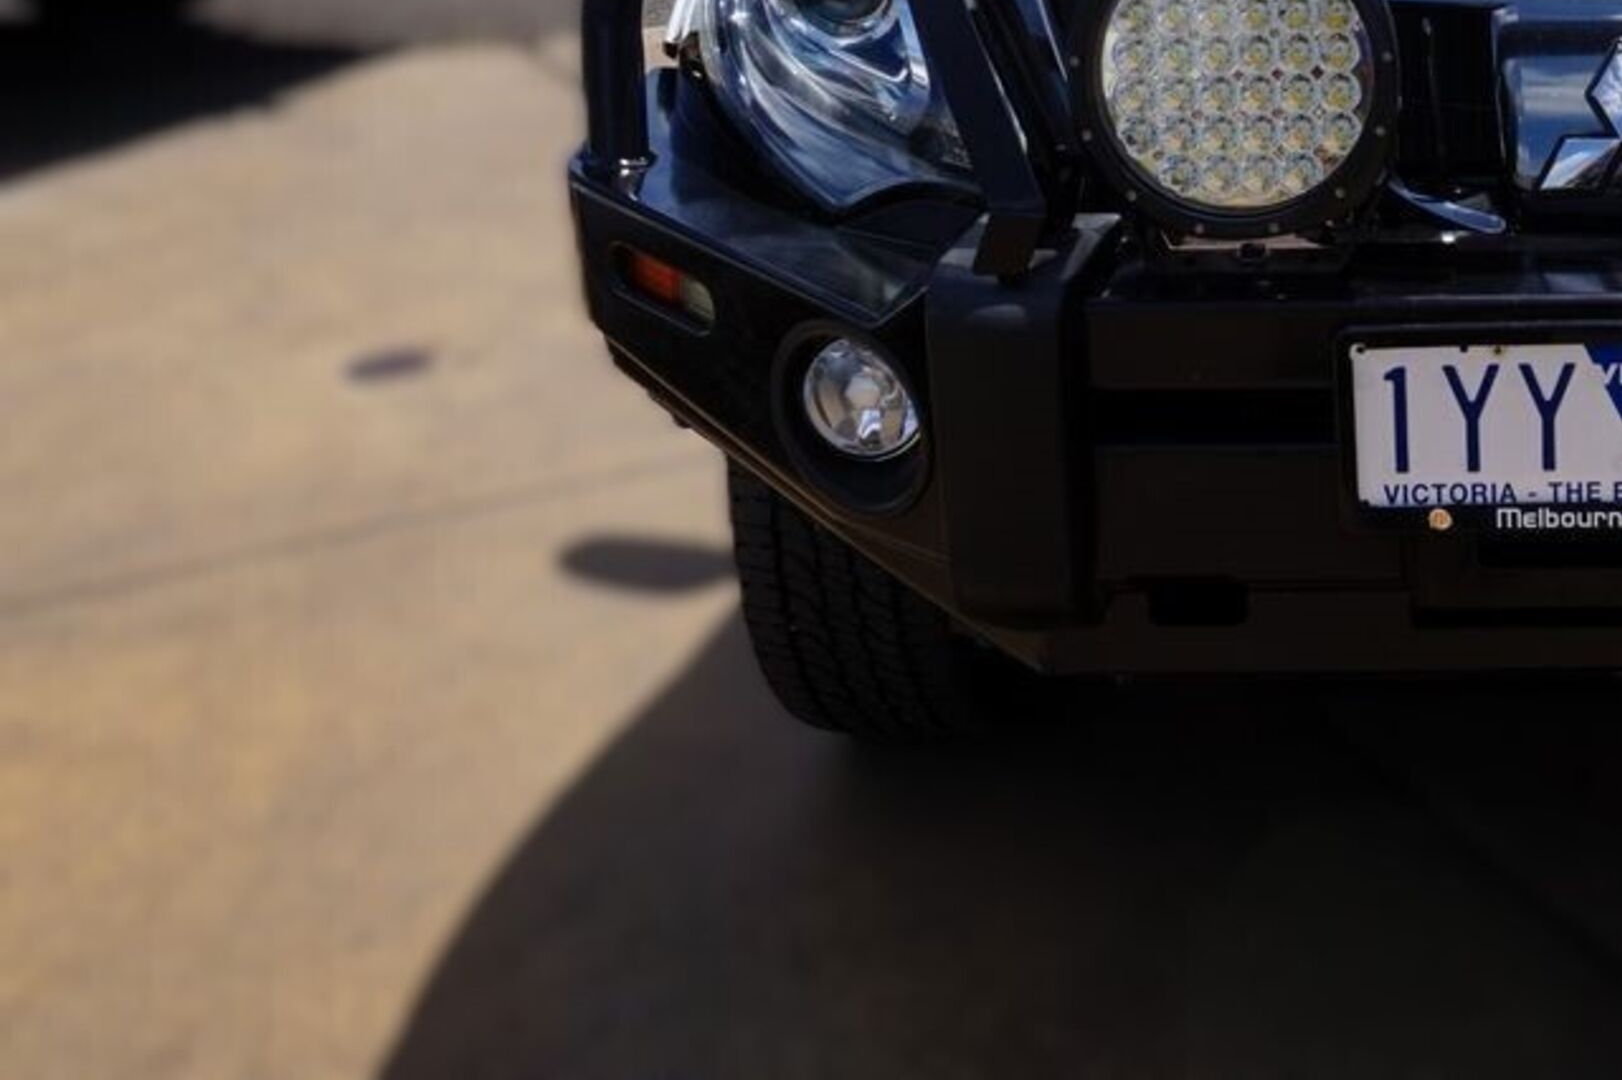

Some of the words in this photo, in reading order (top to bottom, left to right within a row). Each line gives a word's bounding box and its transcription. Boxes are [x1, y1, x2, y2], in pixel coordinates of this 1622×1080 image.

[1383, 362, 1576, 474] 1YY
[1384, 482, 1518, 505] VICTORIA
[1548, 481, 1602, 503] THE
